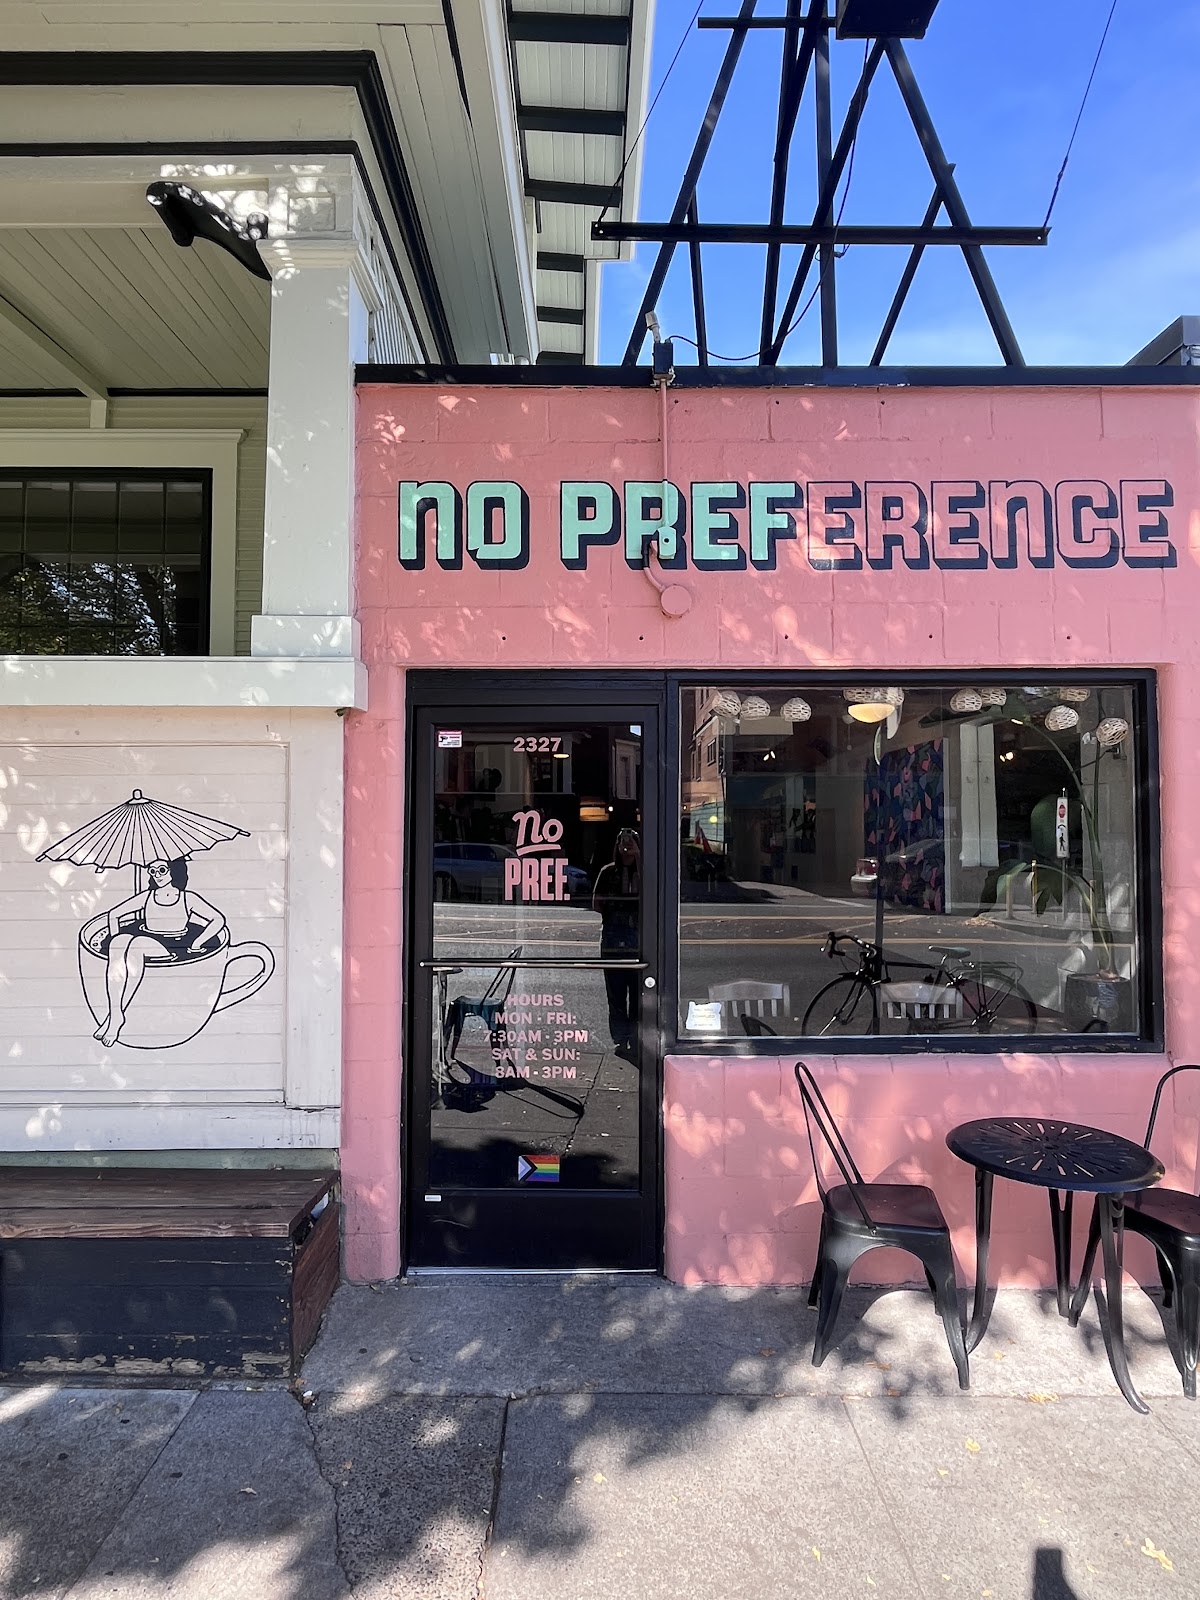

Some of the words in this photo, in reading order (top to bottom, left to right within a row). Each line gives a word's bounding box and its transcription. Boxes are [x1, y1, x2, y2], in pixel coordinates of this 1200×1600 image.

[398, 480, 529, 571] NO
[560, 479, 1177, 571] PREFERENCE
[513, 736, 562, 752] 2327
[504, 858, 571, 900] PREF.
[507, 994, 564, 1007] HOURS
[494, 1012, 533, 1025] MON
[546, 1012, 577, 1025] FRI:
[483, 1030, 542, 1043] 7:30AM
[553, 1030, 589, 1043] 3PM
[491, 1048, 521, 1061] SAT
[525, 1048, 538, 1061] &
[541, 1048, 581, 1061] SUN:
[495, 1066, 530, 1079] 8AM
[541, 1066, 577, 1079] 3PM
